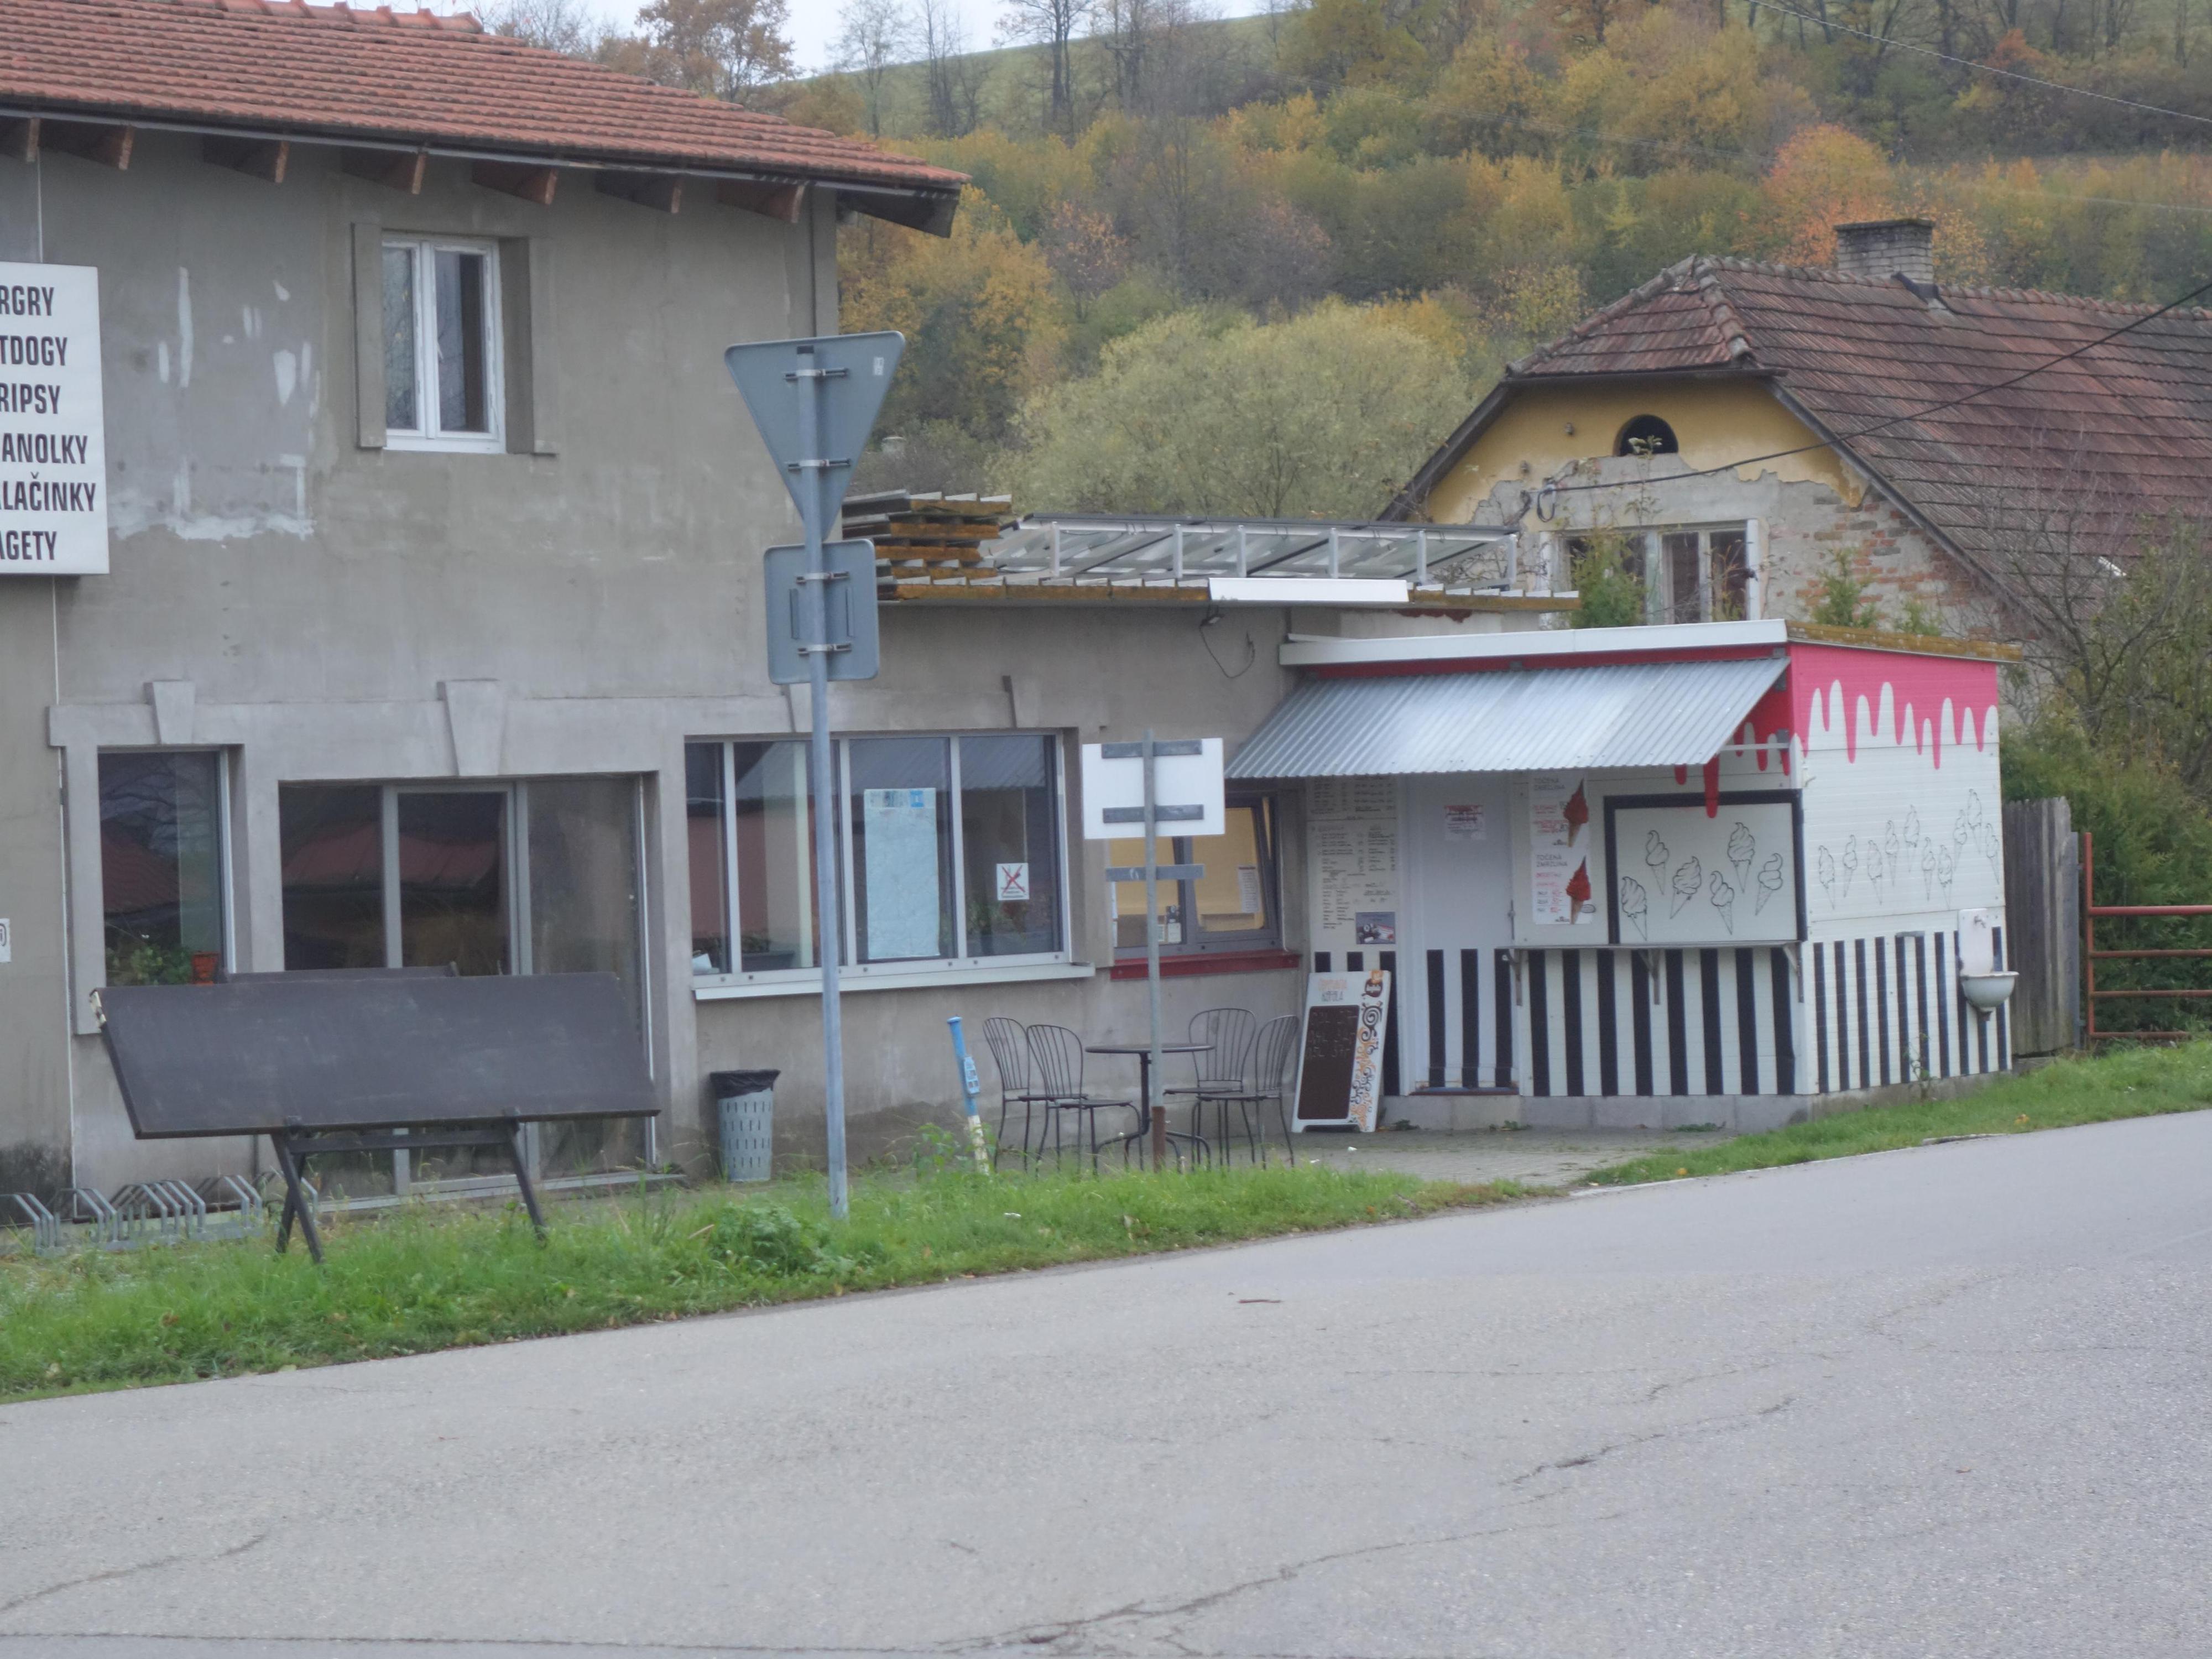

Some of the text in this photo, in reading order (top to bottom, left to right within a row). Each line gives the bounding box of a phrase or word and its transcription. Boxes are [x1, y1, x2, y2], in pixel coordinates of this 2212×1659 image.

[0, 335, 67, 366] TDOGY
[2, 432, 88, 464] ANOLKY
[0, 471, 96, 512] LAČINKY
